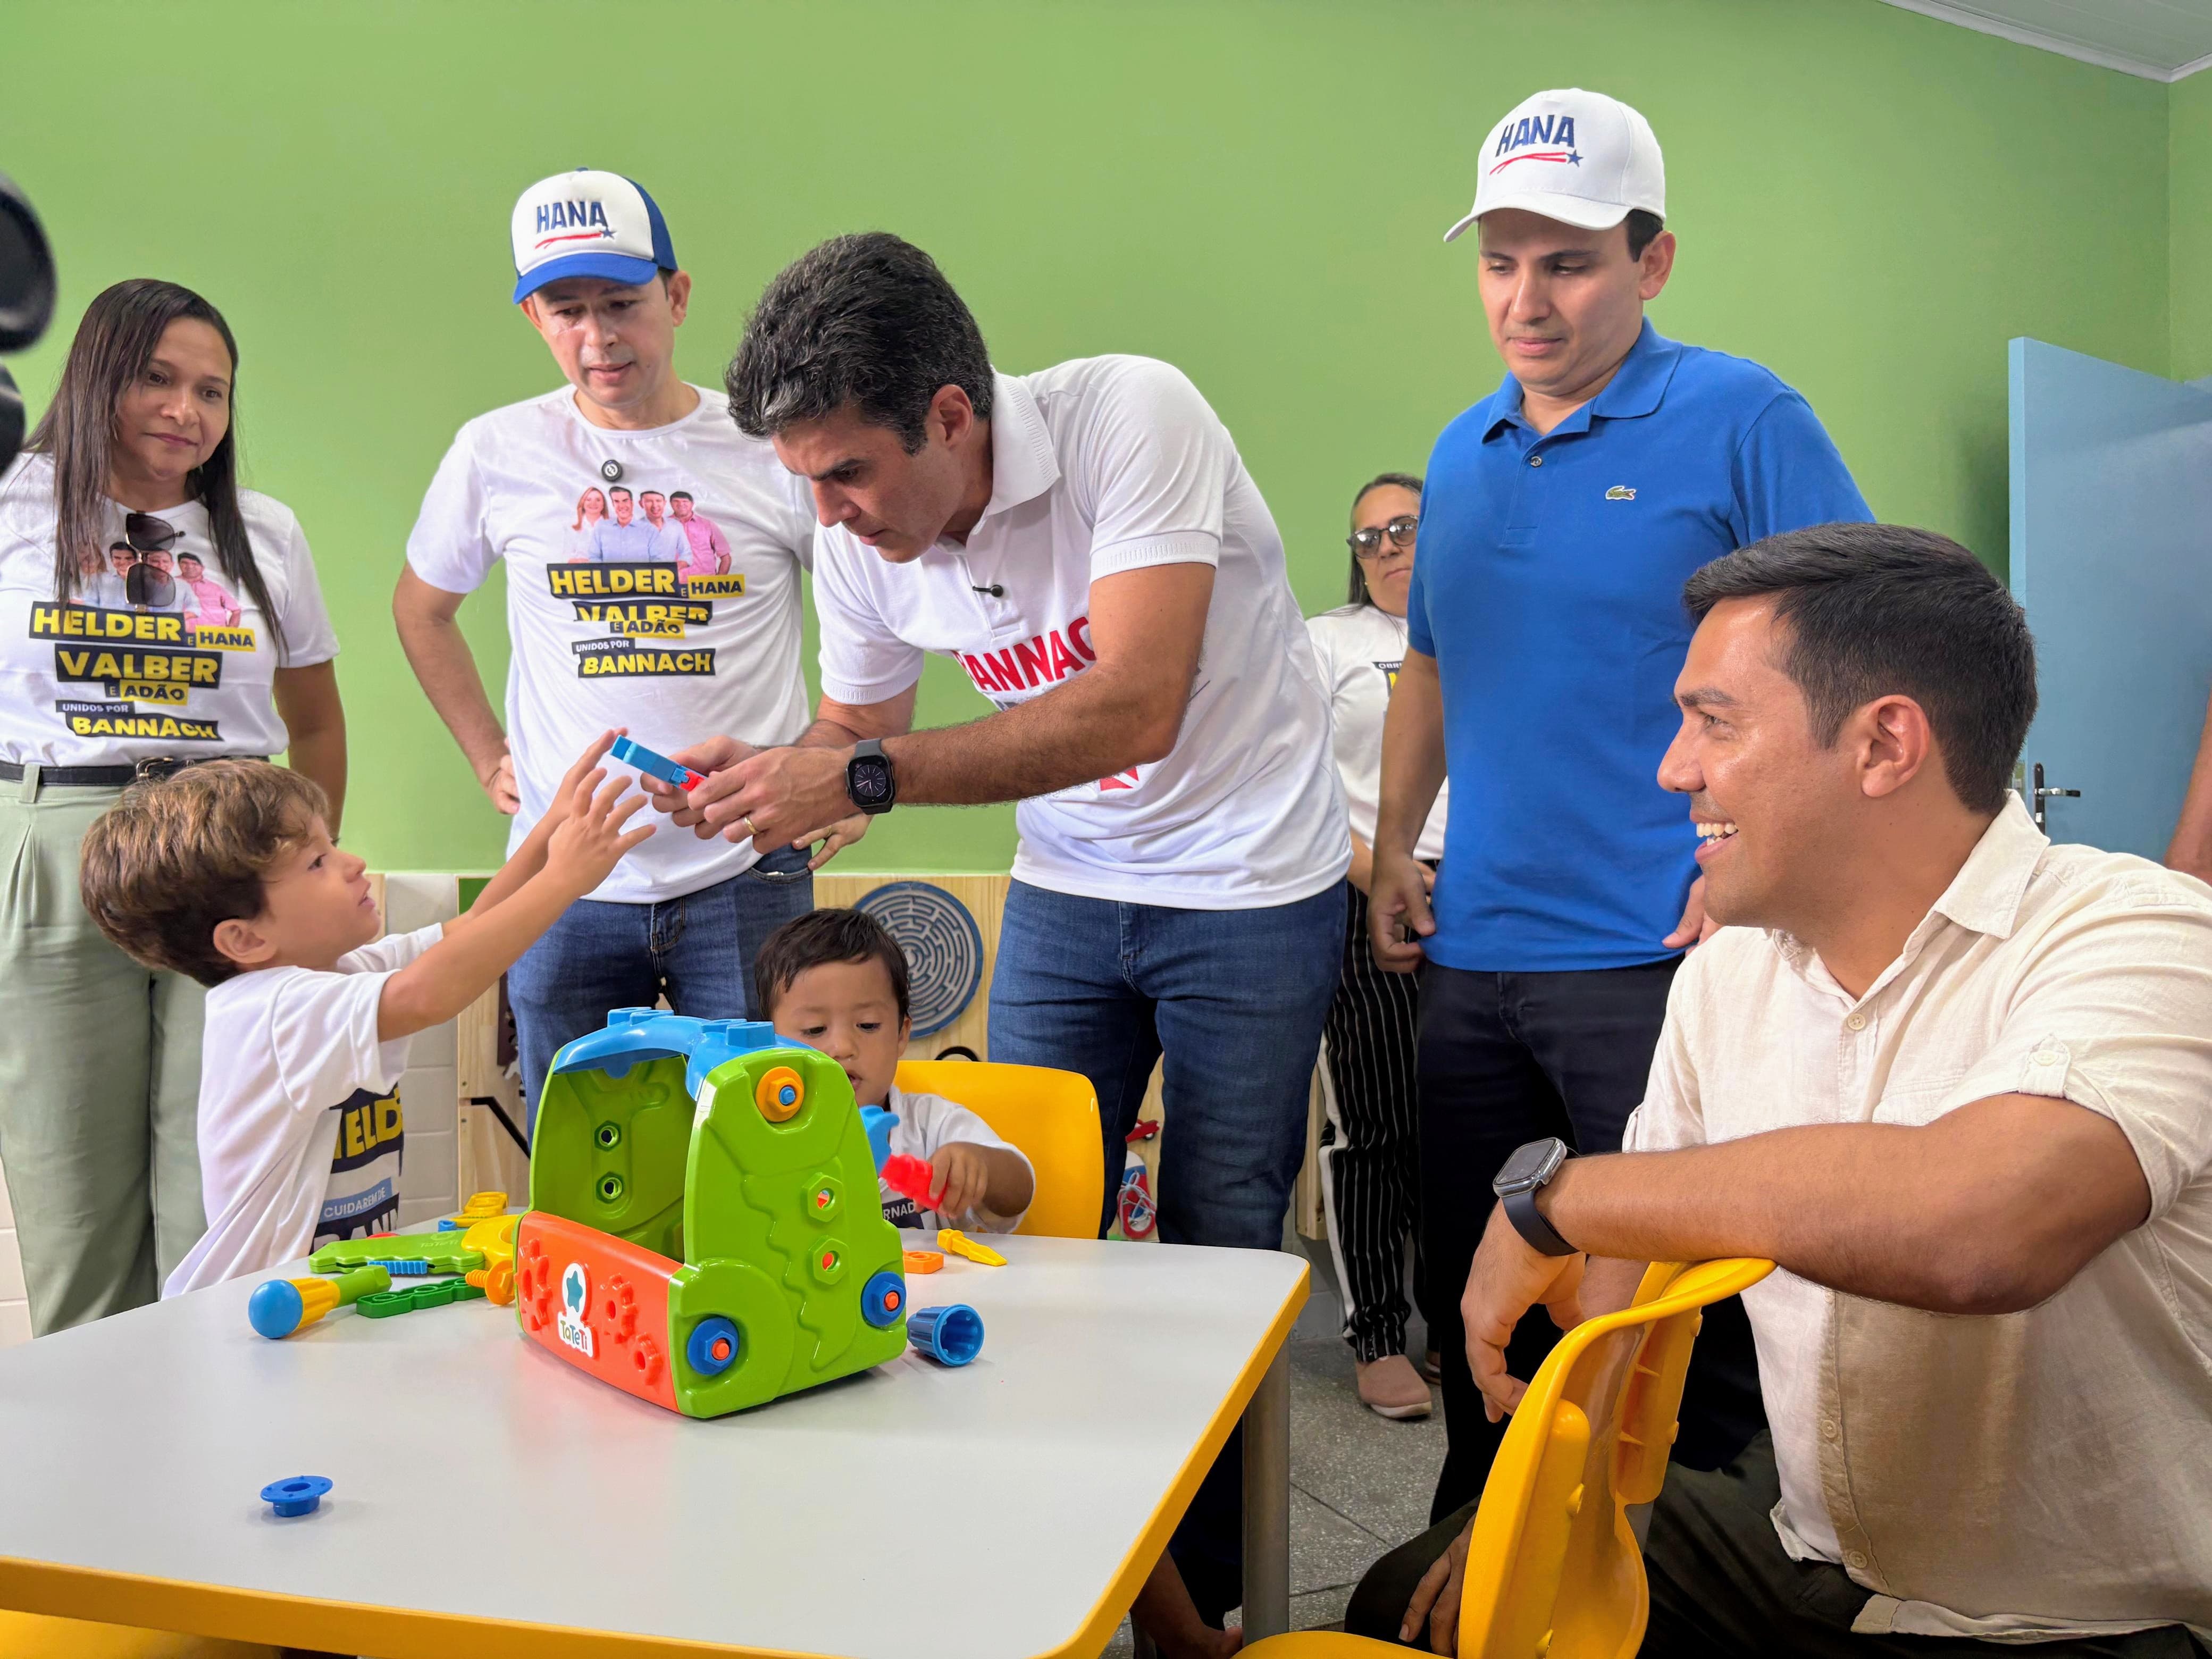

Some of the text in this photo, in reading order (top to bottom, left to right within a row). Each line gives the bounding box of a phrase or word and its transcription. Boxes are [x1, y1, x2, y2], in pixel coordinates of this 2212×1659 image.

[1495, 115, 1574, 157] HANA
[537, 201, 608, 233] HANA
[551, 569, 742, 597] HELDER E HANA
[34, 608, 253, 647] HELDER E HANA
[615, 618, 681, 633] E ADÃO
[576, 641, 609, 652] UNIDOS
[951, 616, 1097, 691] ANNAC
[58, 651, 219, 683] VALBER
[583, 653, 710, 674] BANNACH
[110, 684, 185, 700] E ADÃO
[62, 703, 104, 712] UNIDOS
[72, 717, 217, 739] BANNACH
[333, 1088, 403, 1159] ELD
[324, 1192, 378, 1218] CUIDAREM
[883, 1202, 915, 1221] RNAD
[560, 1320, 588, 1350] TaTeTi
